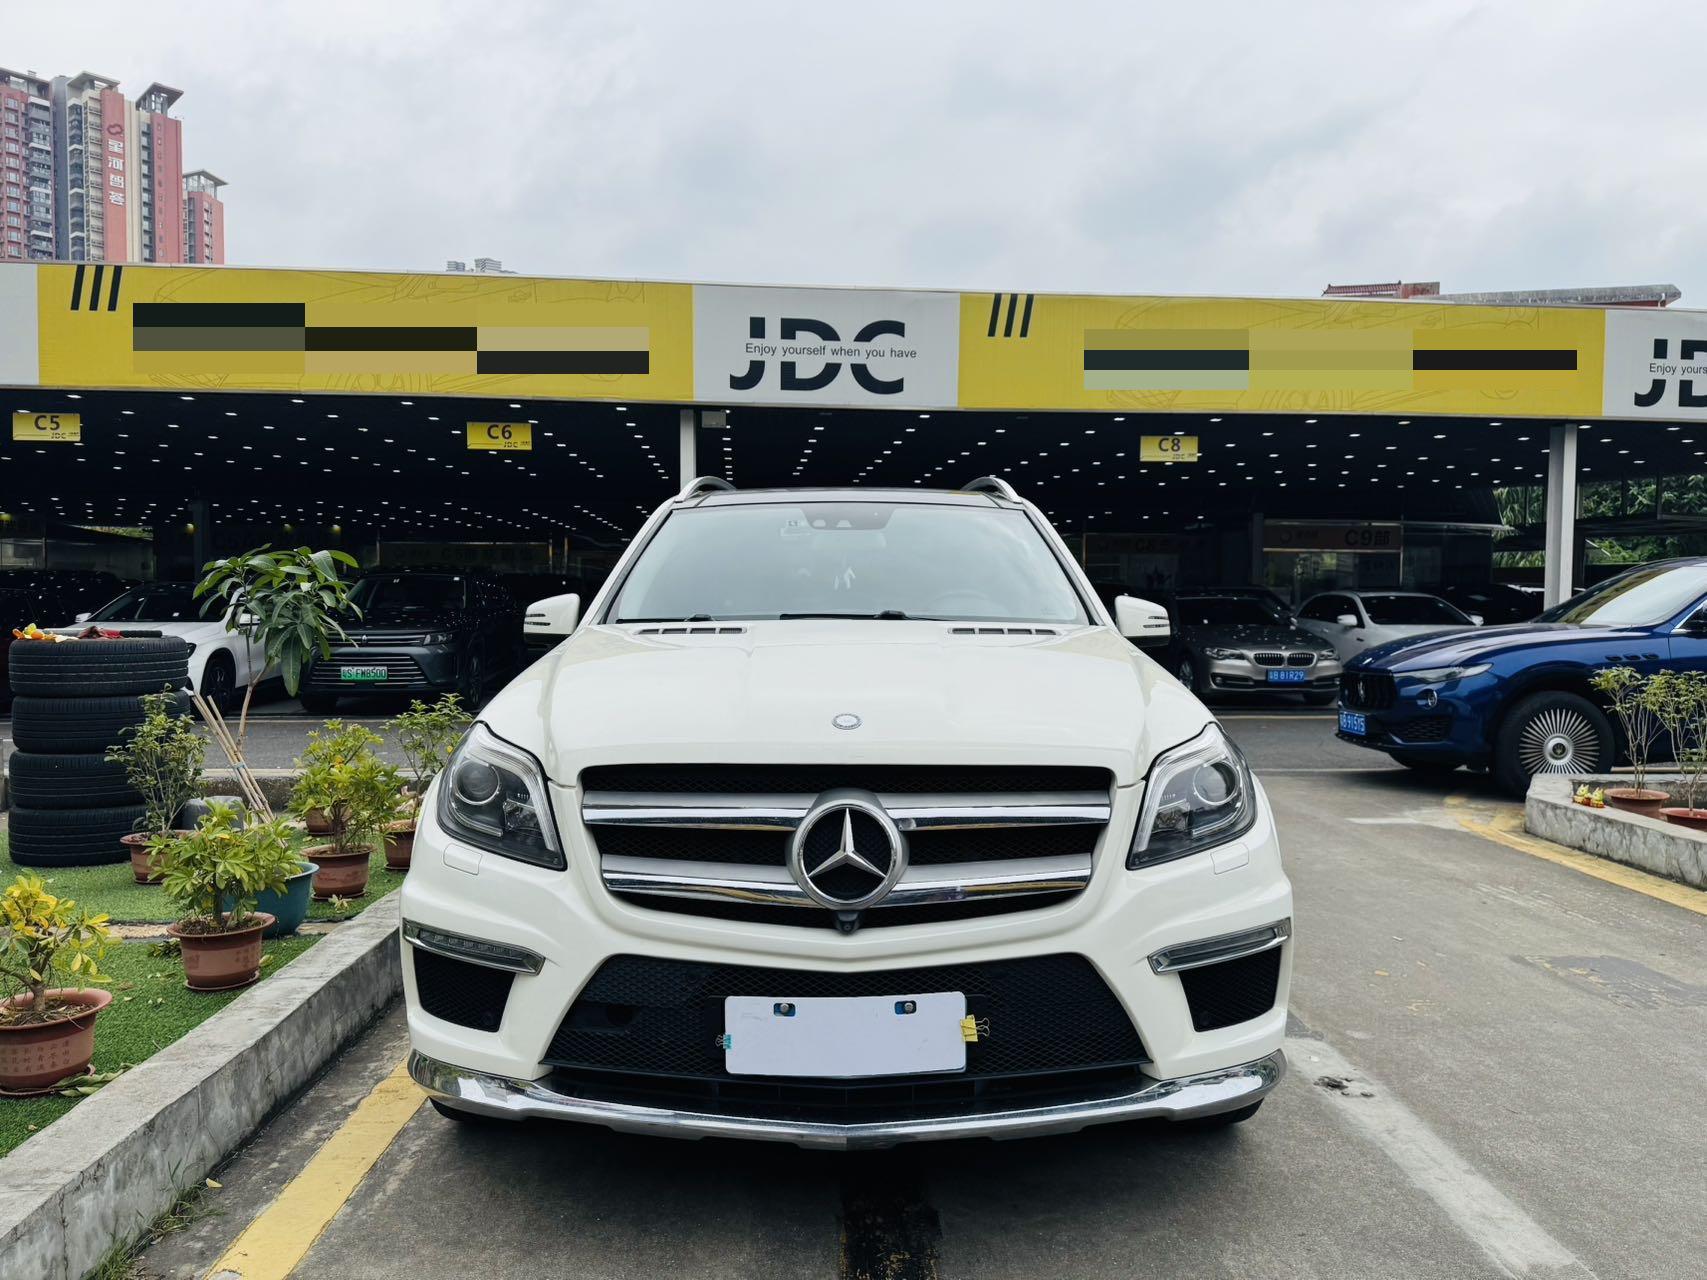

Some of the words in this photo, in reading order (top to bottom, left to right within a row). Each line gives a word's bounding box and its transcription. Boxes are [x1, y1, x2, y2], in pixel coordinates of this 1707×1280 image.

[730, 316, 905, 395] JDC
[745, 342, 777, 357] Enjoy
[782, 345, 827, 357] yourself
[831, 346, 861, 357] when
[865, 349, 885, 359] you
[890, 347, 917, 358] have
[1649, 362, 1677, 375] Enjoy
[34, 414, 60, 431] C5
[487, 424, 512, 440] C6
[1158, 437, 1181, 452] C8
